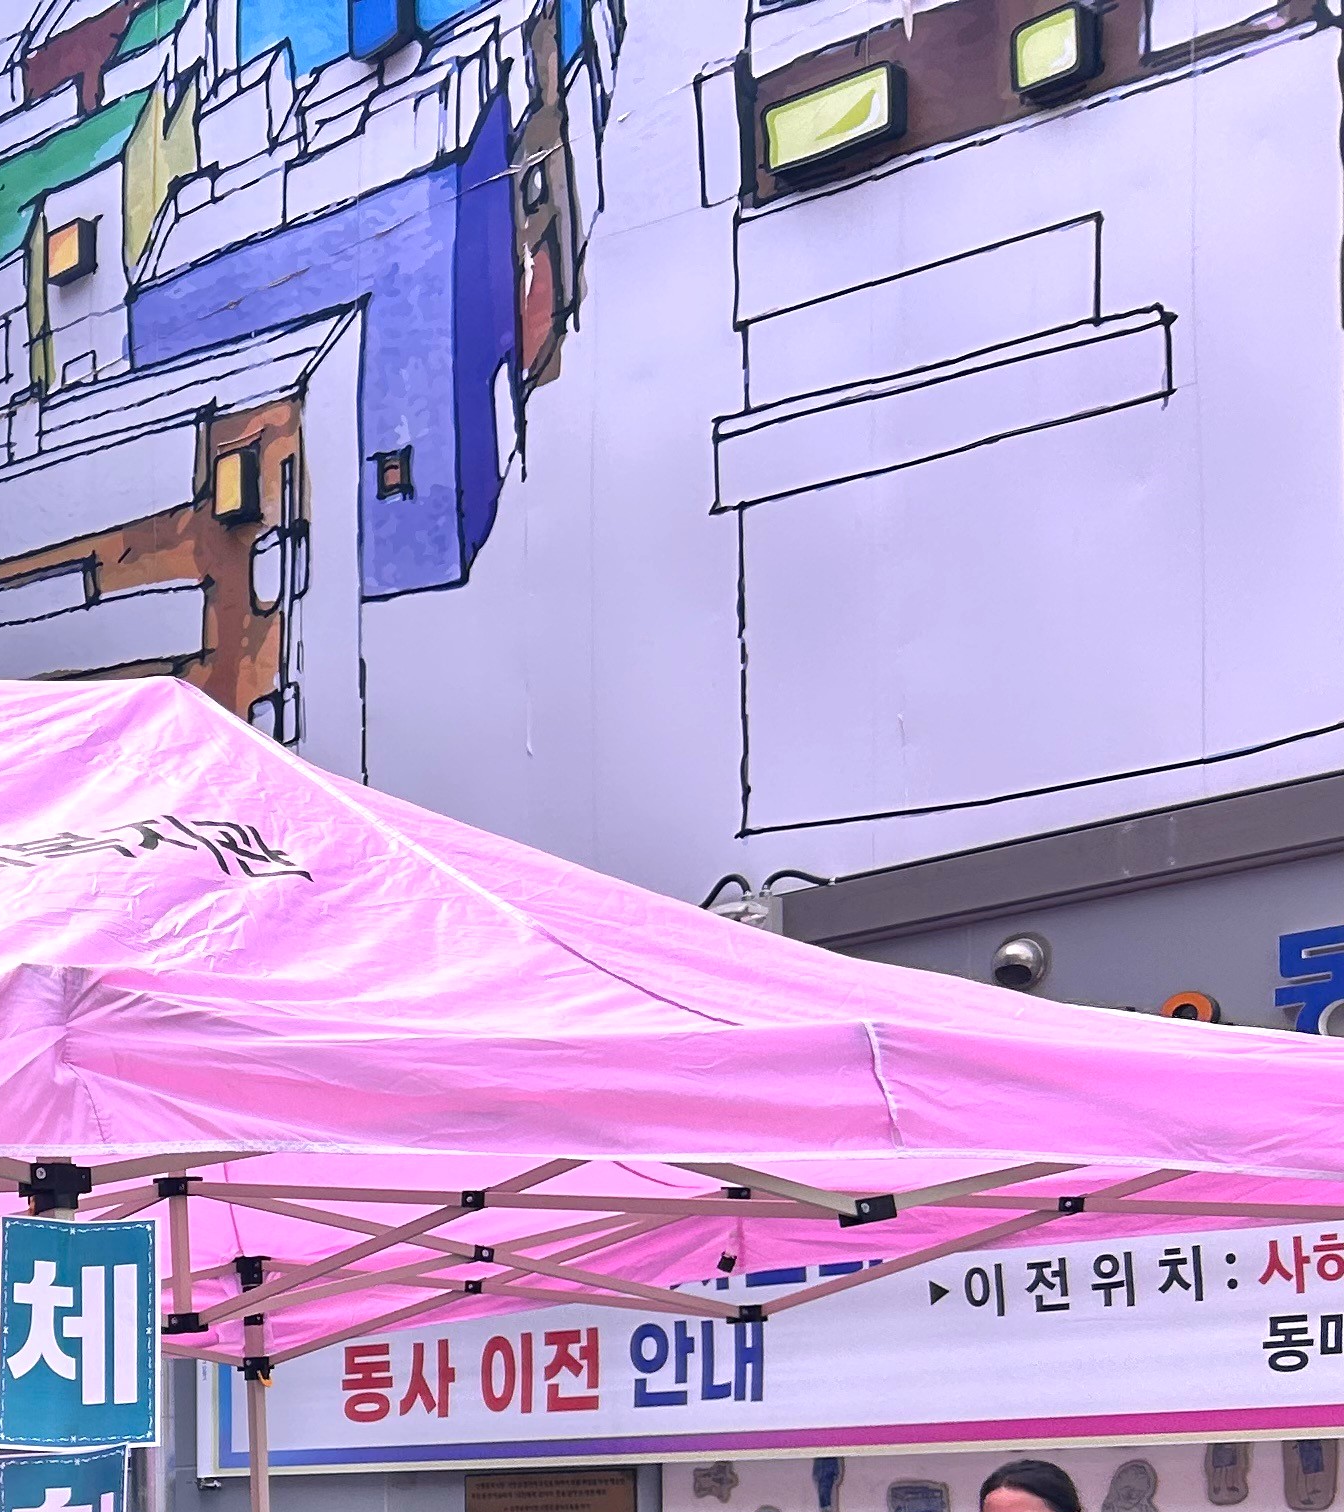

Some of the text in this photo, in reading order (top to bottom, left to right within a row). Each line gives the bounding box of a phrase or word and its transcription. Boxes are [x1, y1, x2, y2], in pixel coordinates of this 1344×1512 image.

[341, 1319, 764, 1423] 동사 이전 안내
